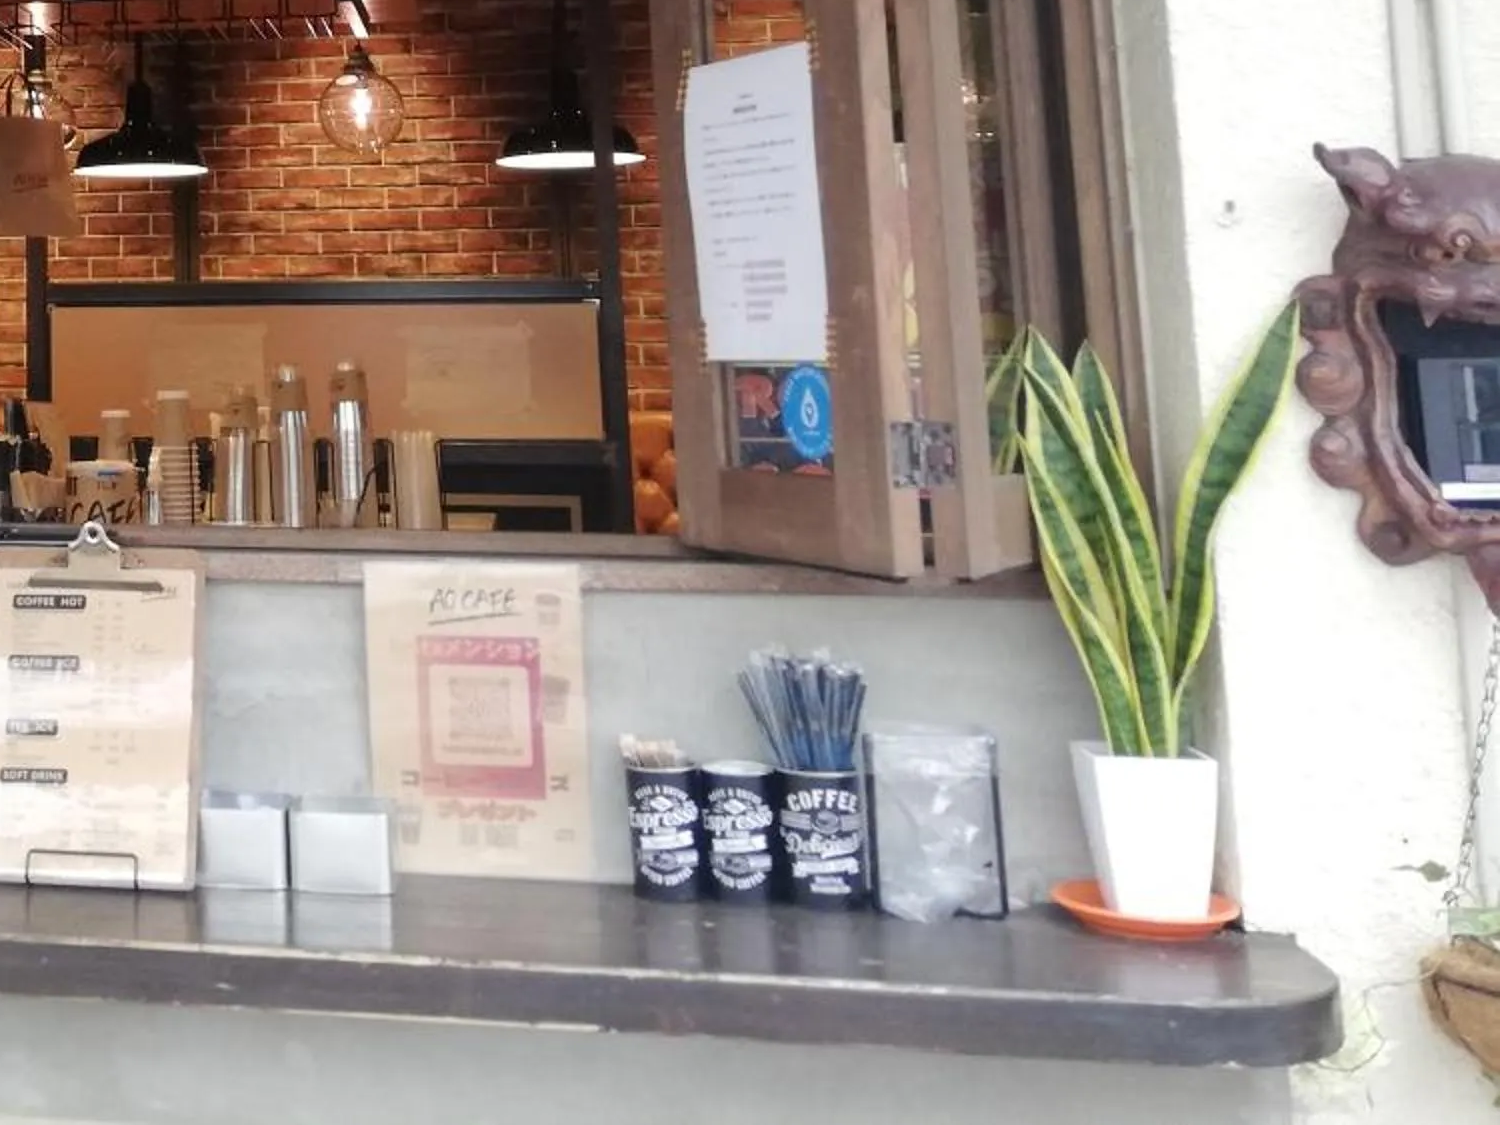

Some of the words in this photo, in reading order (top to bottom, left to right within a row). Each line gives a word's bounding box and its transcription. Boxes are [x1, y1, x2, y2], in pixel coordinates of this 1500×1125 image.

[15, 596, 56, 607] COFFEE
[60, 596, 85, 608] HOT
[786, 788, 858, 814] COFFEE
